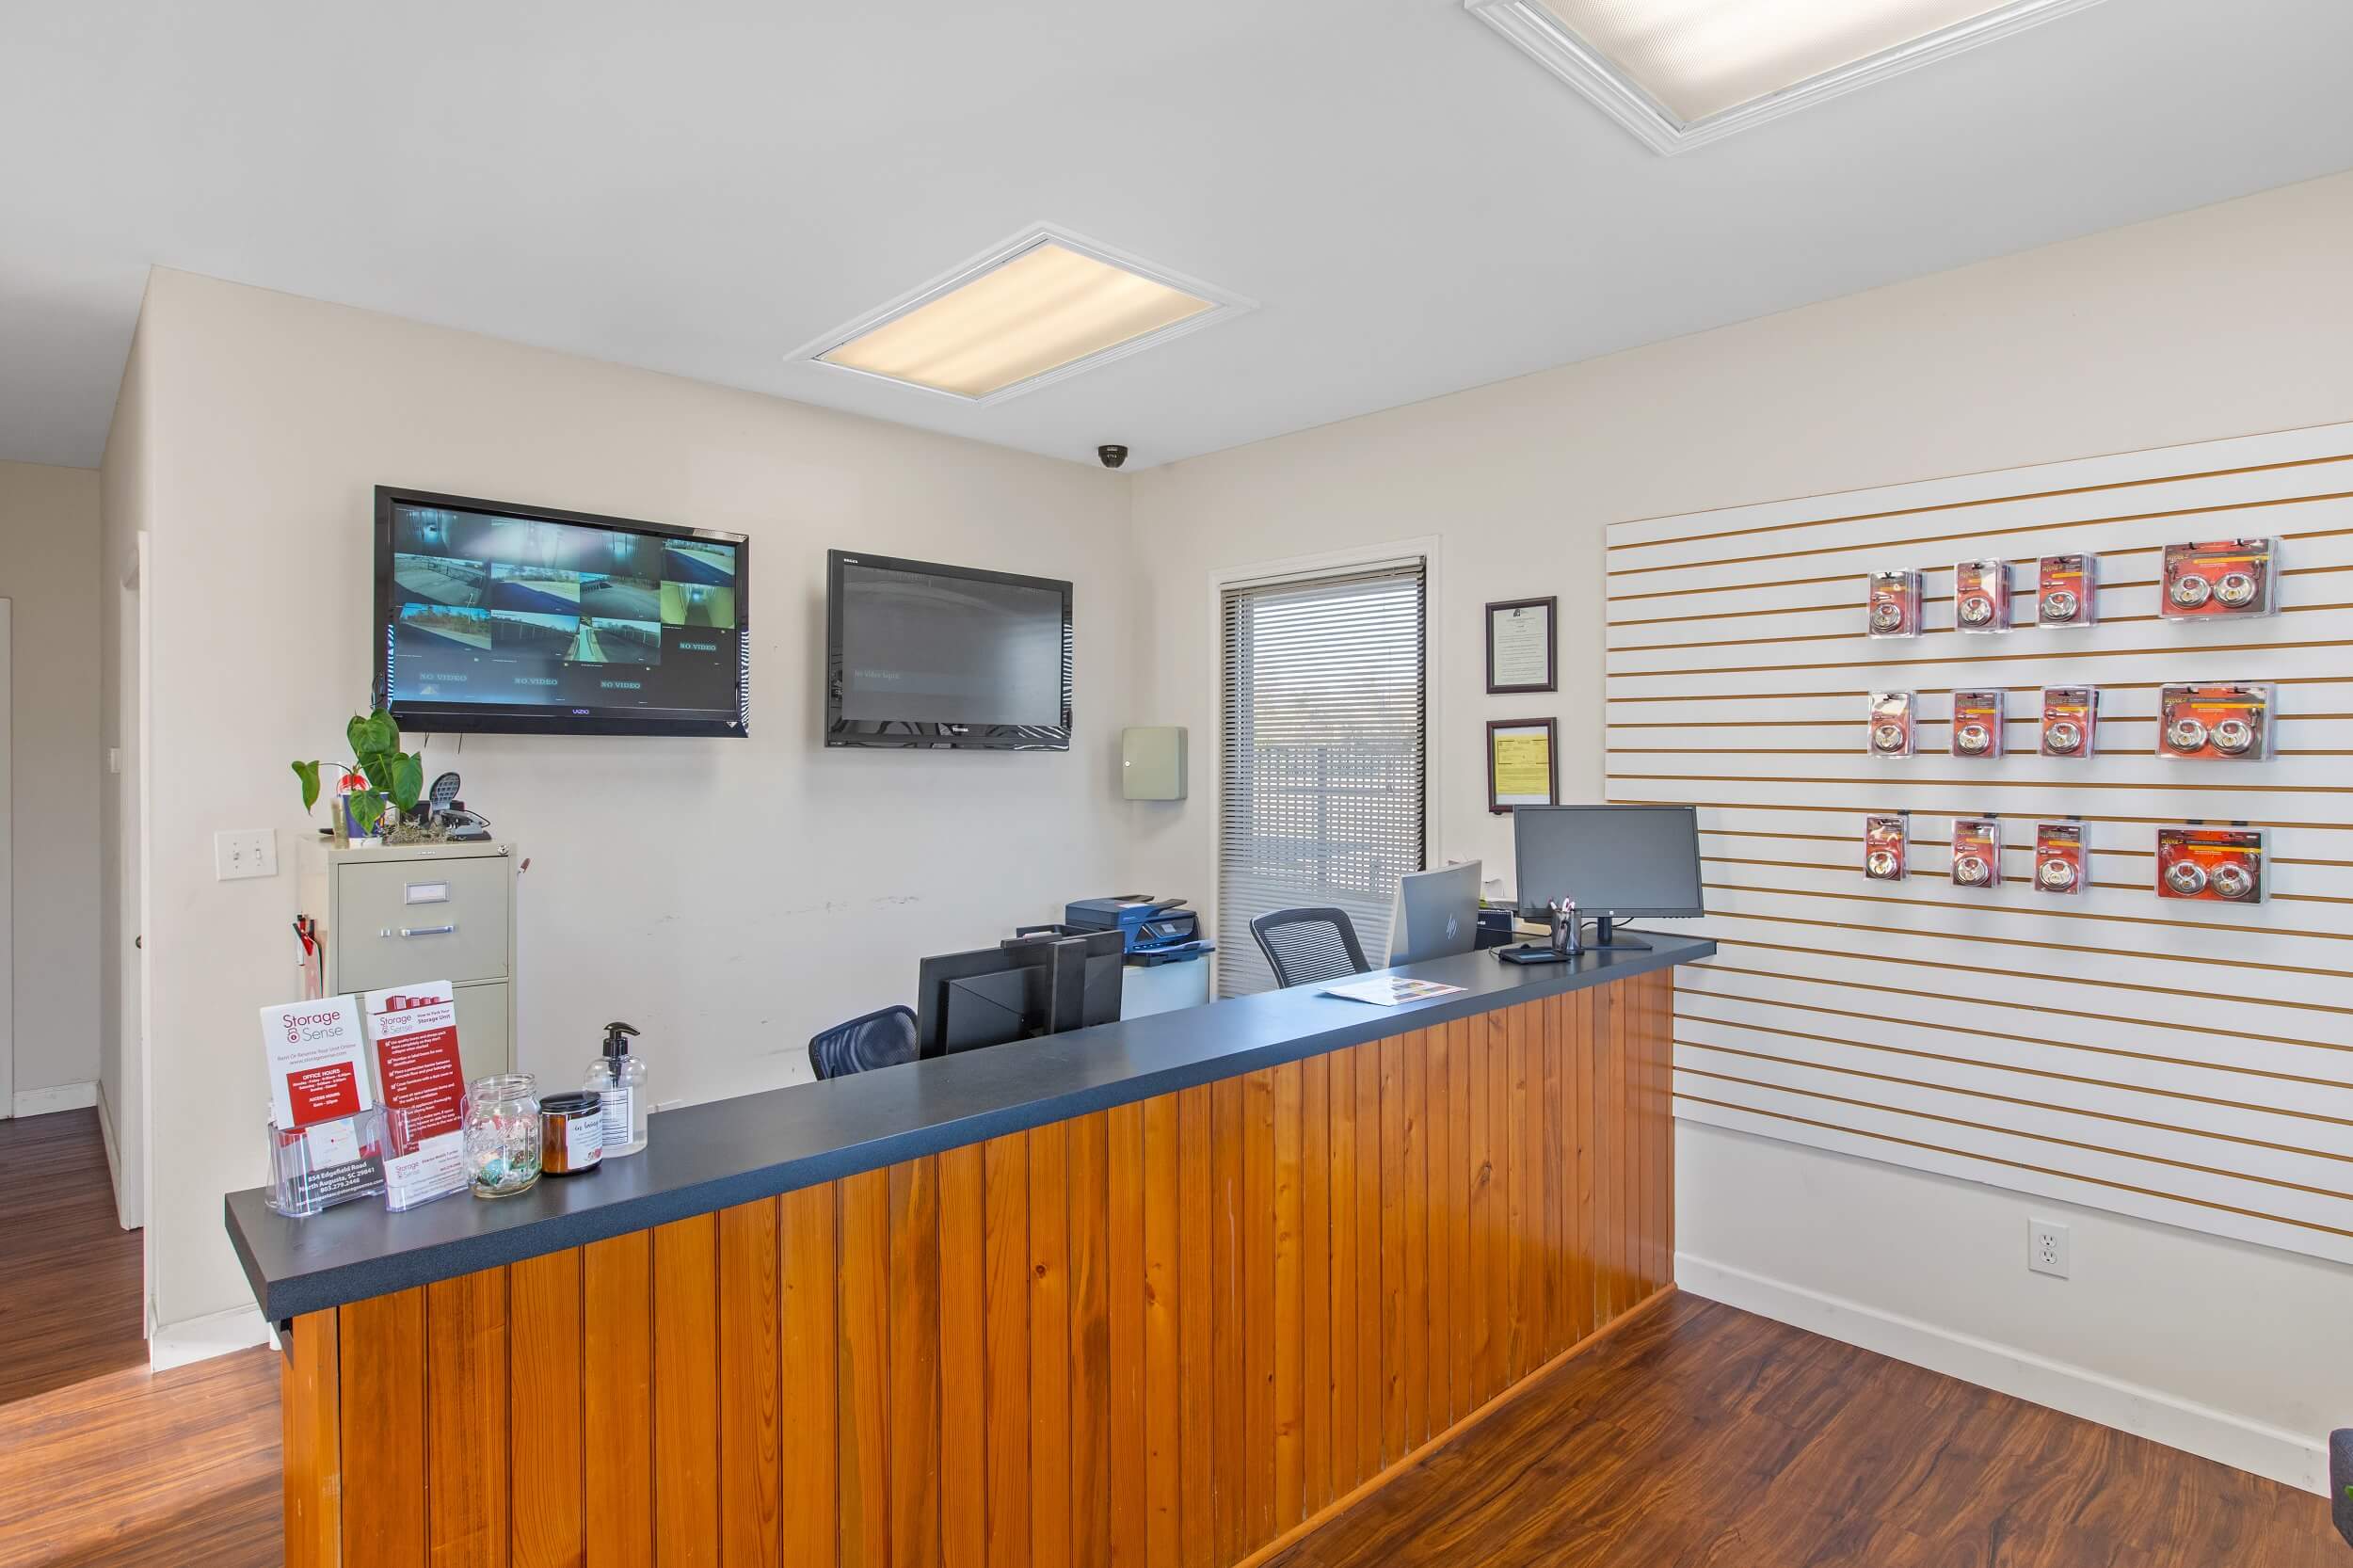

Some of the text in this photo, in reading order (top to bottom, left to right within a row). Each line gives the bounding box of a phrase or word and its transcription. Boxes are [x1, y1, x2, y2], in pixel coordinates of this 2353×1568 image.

[693, 643, 716, 651] VIDEO
[420, 672, 468, 682] NO VIDEO
[282, 1011, 341, 1028] Storage
[379, 1015, 412, 1026] Storage
[302, 1027, 344, 1042] Sense
[302, 1072, 321, 1080] OFFICE
[322, 1068, 341, 1077] HOURS
[321, 1165, 351, 1179] Edgefield
[351, 1160, 368, 1171] Road
[396, 1161, 420, 1171] Storage
[320, 1175, 347, 1187] Augusta,
[347, 1170, 357, 1178] SC
